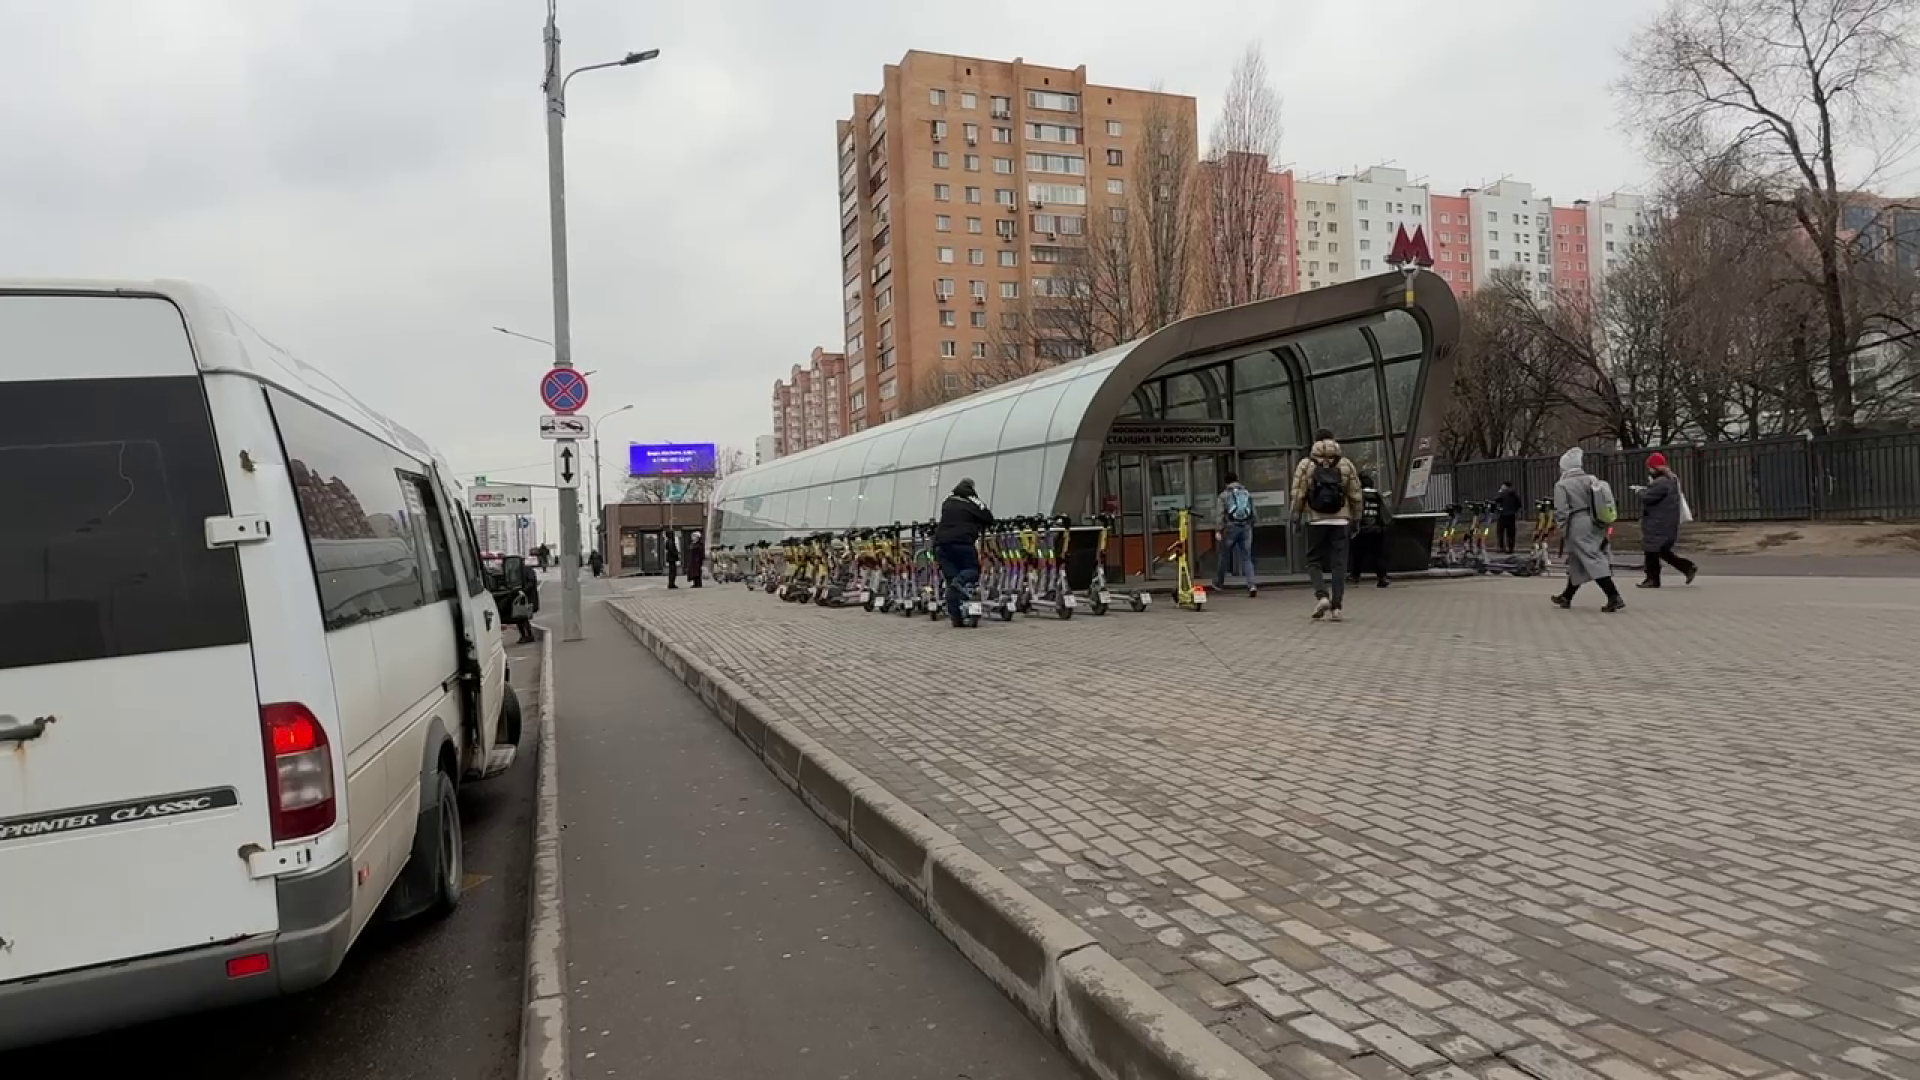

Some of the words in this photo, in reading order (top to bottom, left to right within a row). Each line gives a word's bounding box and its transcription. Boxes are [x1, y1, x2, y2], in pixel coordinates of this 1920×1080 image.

[1106, 435, 1151, 445] СТАНЦИЯ
[1154, 434, 1222, 444] НОВОКОСИНО
[110, 797, 211, 821] CLASSIC
